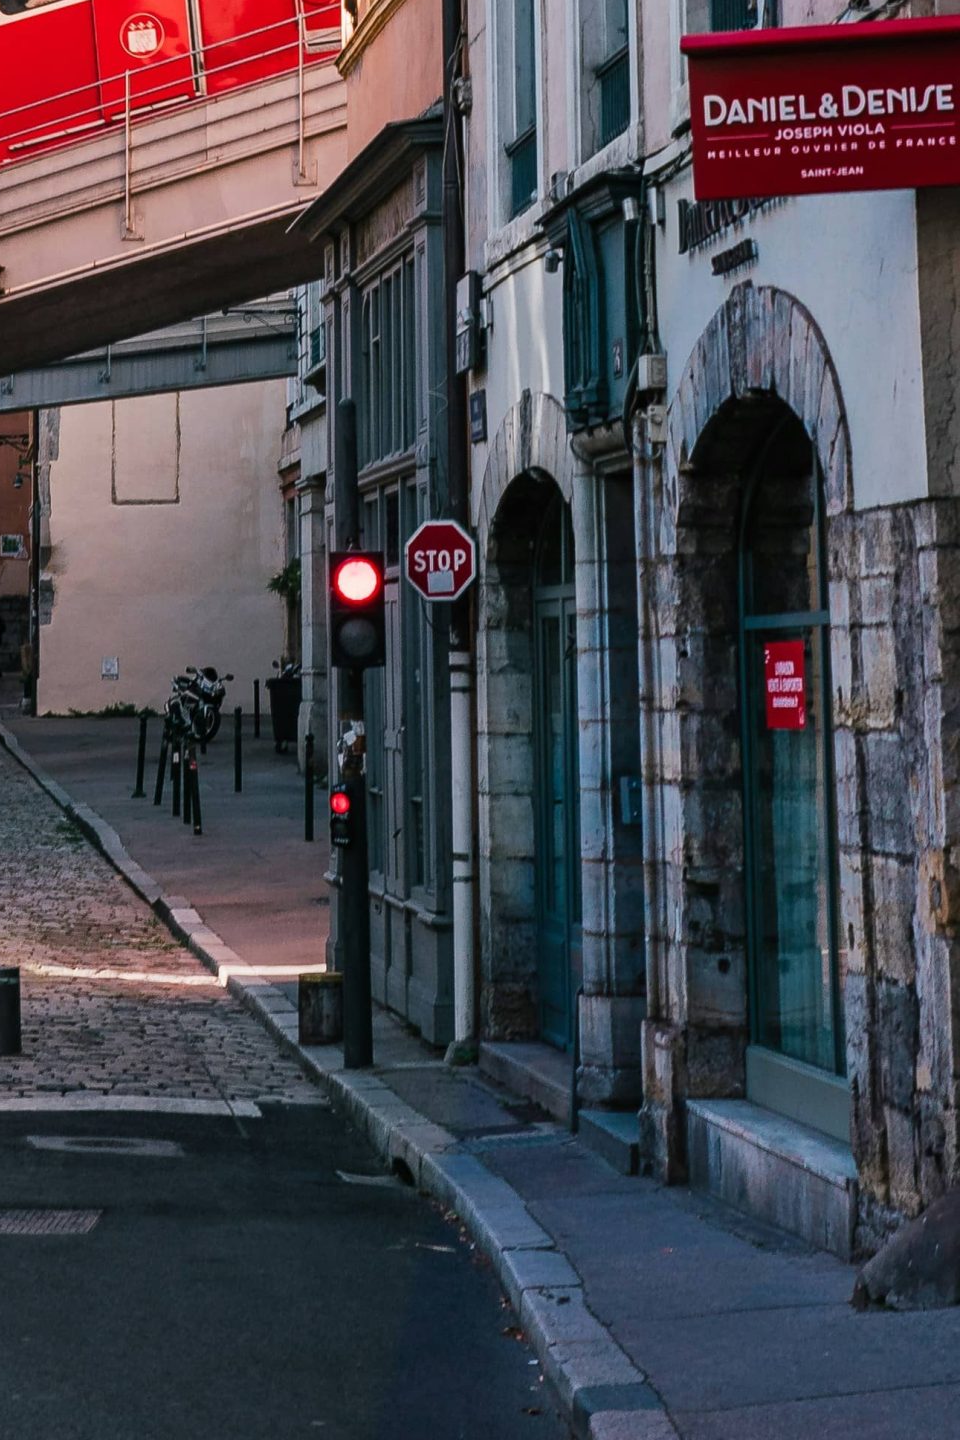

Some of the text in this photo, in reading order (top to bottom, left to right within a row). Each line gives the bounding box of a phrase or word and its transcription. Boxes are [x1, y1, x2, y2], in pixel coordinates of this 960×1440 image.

[774, 122, 885, 141] JOSEPH VIOLA
[707, 135, 957, 160] MEILLEUR OUVRIER DE FRANCE
[800, 165, 864, 179] SAINT-JEAN
[414, 549, 467, 573] STOP
